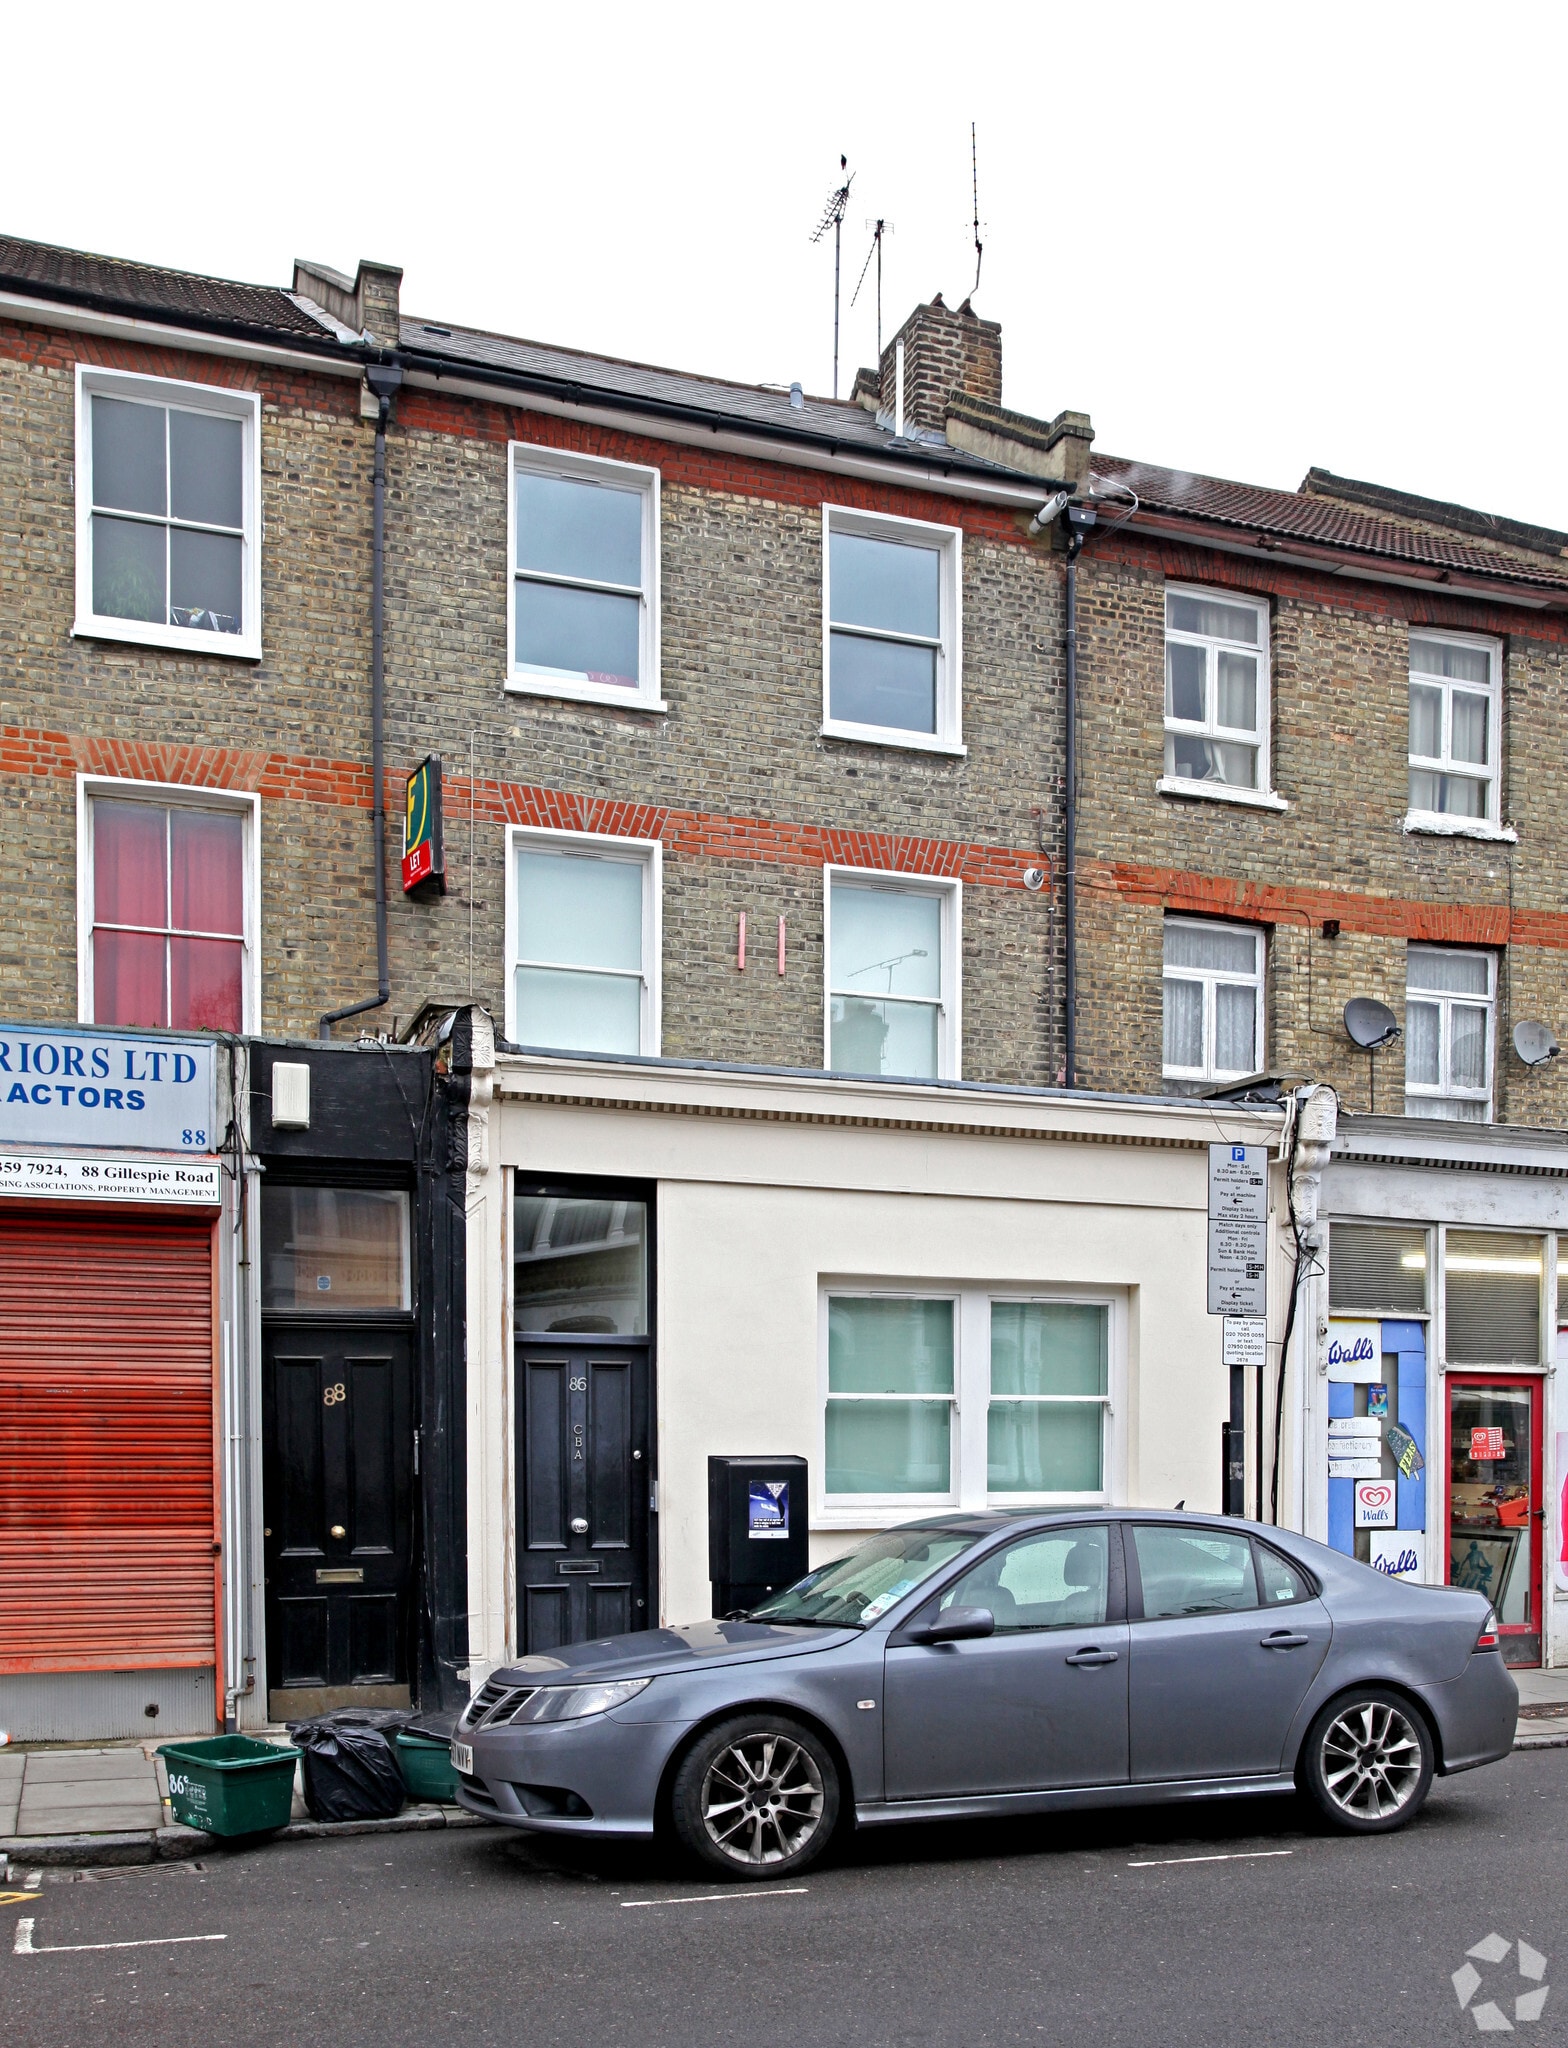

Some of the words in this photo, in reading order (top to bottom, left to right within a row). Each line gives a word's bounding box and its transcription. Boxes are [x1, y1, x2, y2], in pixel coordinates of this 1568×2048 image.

[410, 850, 420, 871] LET
[124, 1050, 197, 1083] LTD
[7, 1083, 146, 1110] ACTORS
[182, 1129, 206, 1145] 88
[1235, 1149, 1244, 1160] P
[0, 1162, 22, 1174] 59
[27, 1163, 67, 1178] 7924,
[81, 1166, 99, 1177] 88
[104, 1167, 170, 1183] Gillespie
[175, 1171, 214, 1183] Road
[24, 1182, 96, 1192] ASSOCIATIONS,
[98, 1185, 147, 1194] PROPERTY
[149, 1187, 217, 1197] MANAGEMENT
[1328, 1337, 1374, 1365] Wall's
[569, 1377, 587, 1391] 86
[323, 1383, 346, 1406] 88
[573, 1424, 583, 1434] C
[575, 1437, 582, 1447] B
[574, 1450, 582, 1459] A
[1363, 1509, 1389, 1520] Wall's
[1373, 1549, 1418, 1575] Wall's
